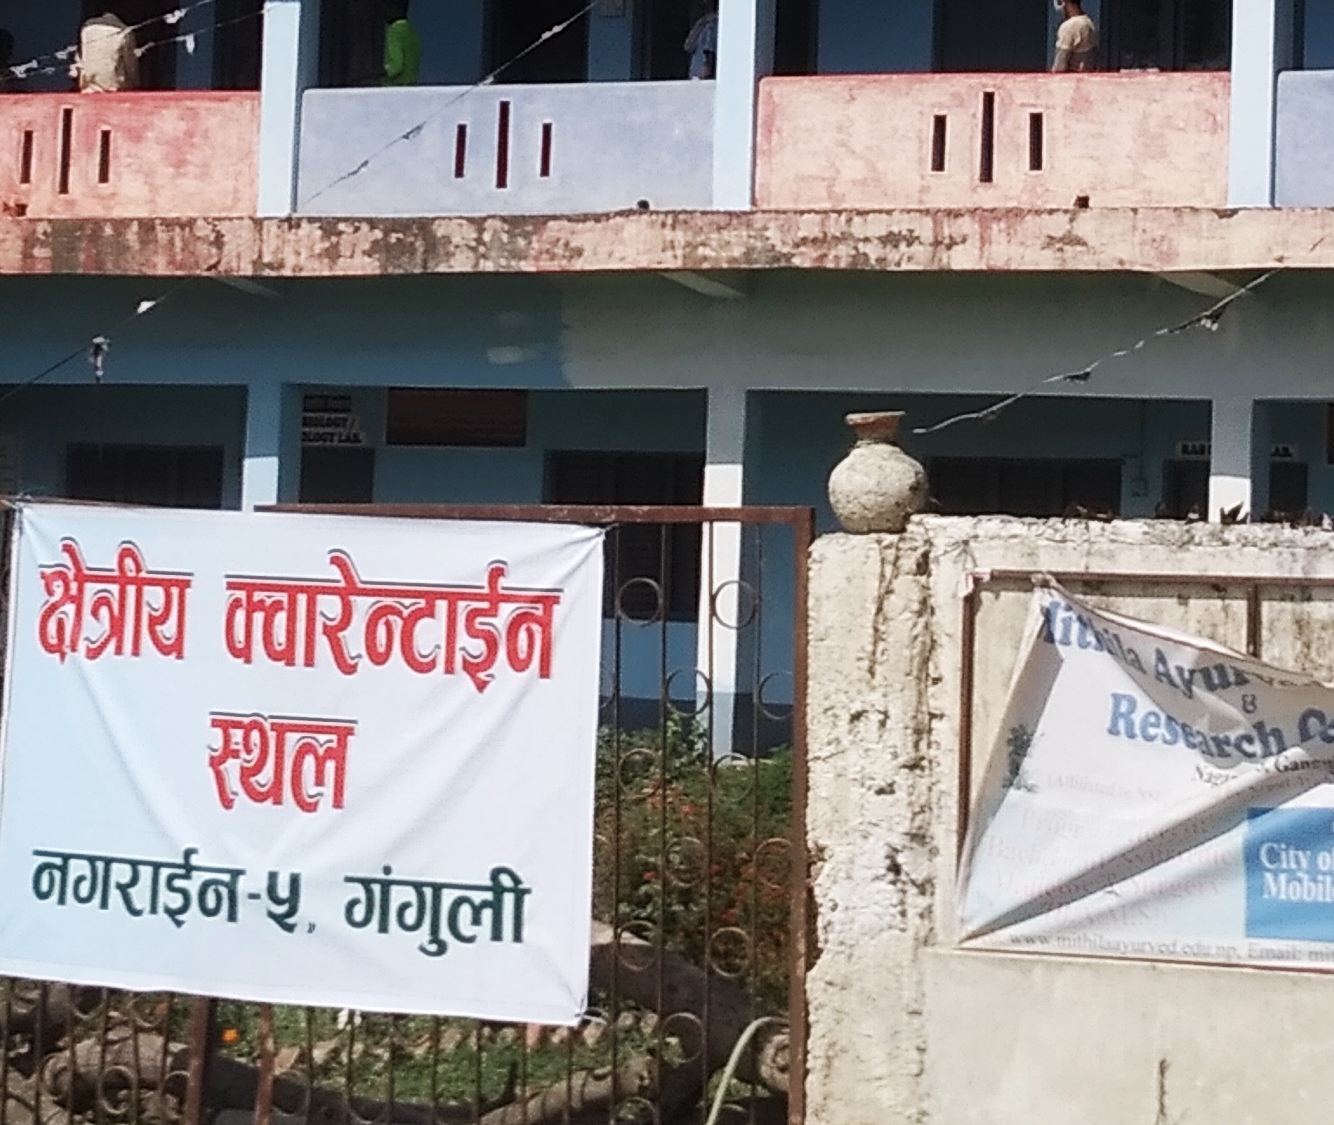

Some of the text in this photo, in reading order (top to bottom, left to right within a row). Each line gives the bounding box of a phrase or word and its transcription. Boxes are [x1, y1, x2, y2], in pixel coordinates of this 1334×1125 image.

[38, 536, 564, 693] क्षेत्रीय क्वारेन्टाईन
[207, 712, 358, 813] स्थल
[1106, 691, 1287, 760] Research
[1259, 842, 1312, 873] City
[343, 864, 532, 957] गंगुली
